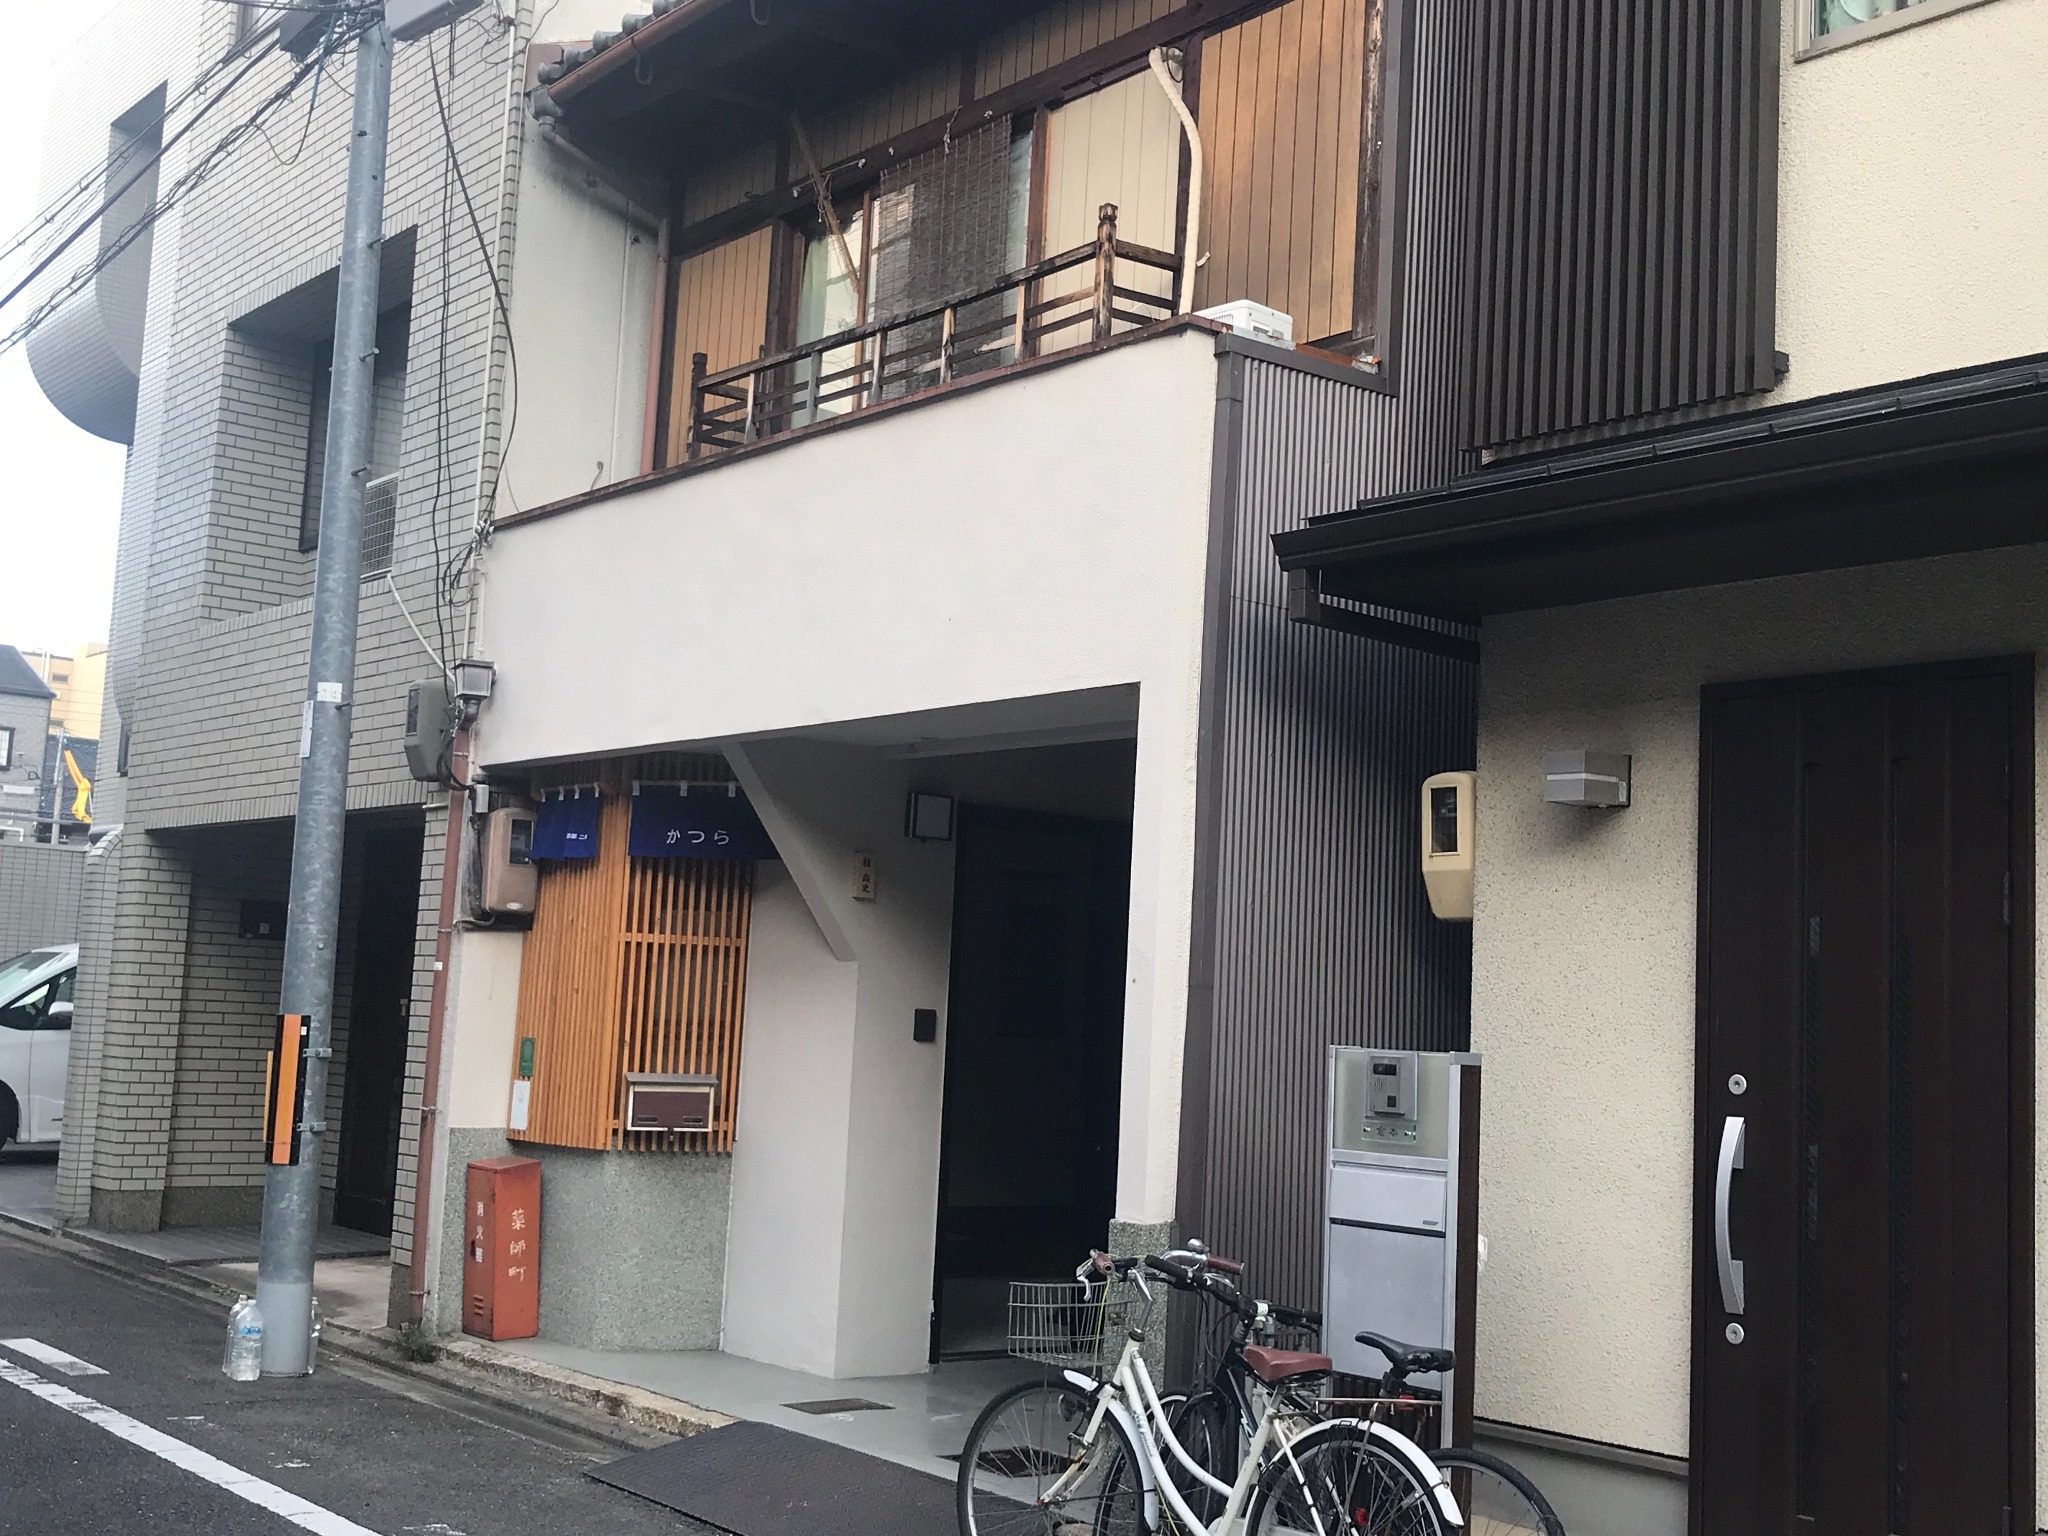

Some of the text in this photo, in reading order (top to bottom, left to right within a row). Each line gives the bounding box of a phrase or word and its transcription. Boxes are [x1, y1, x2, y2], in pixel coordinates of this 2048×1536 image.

[666, 829, 730, 845] かつら
[508, 1208, 526, 1282] 薬師町
